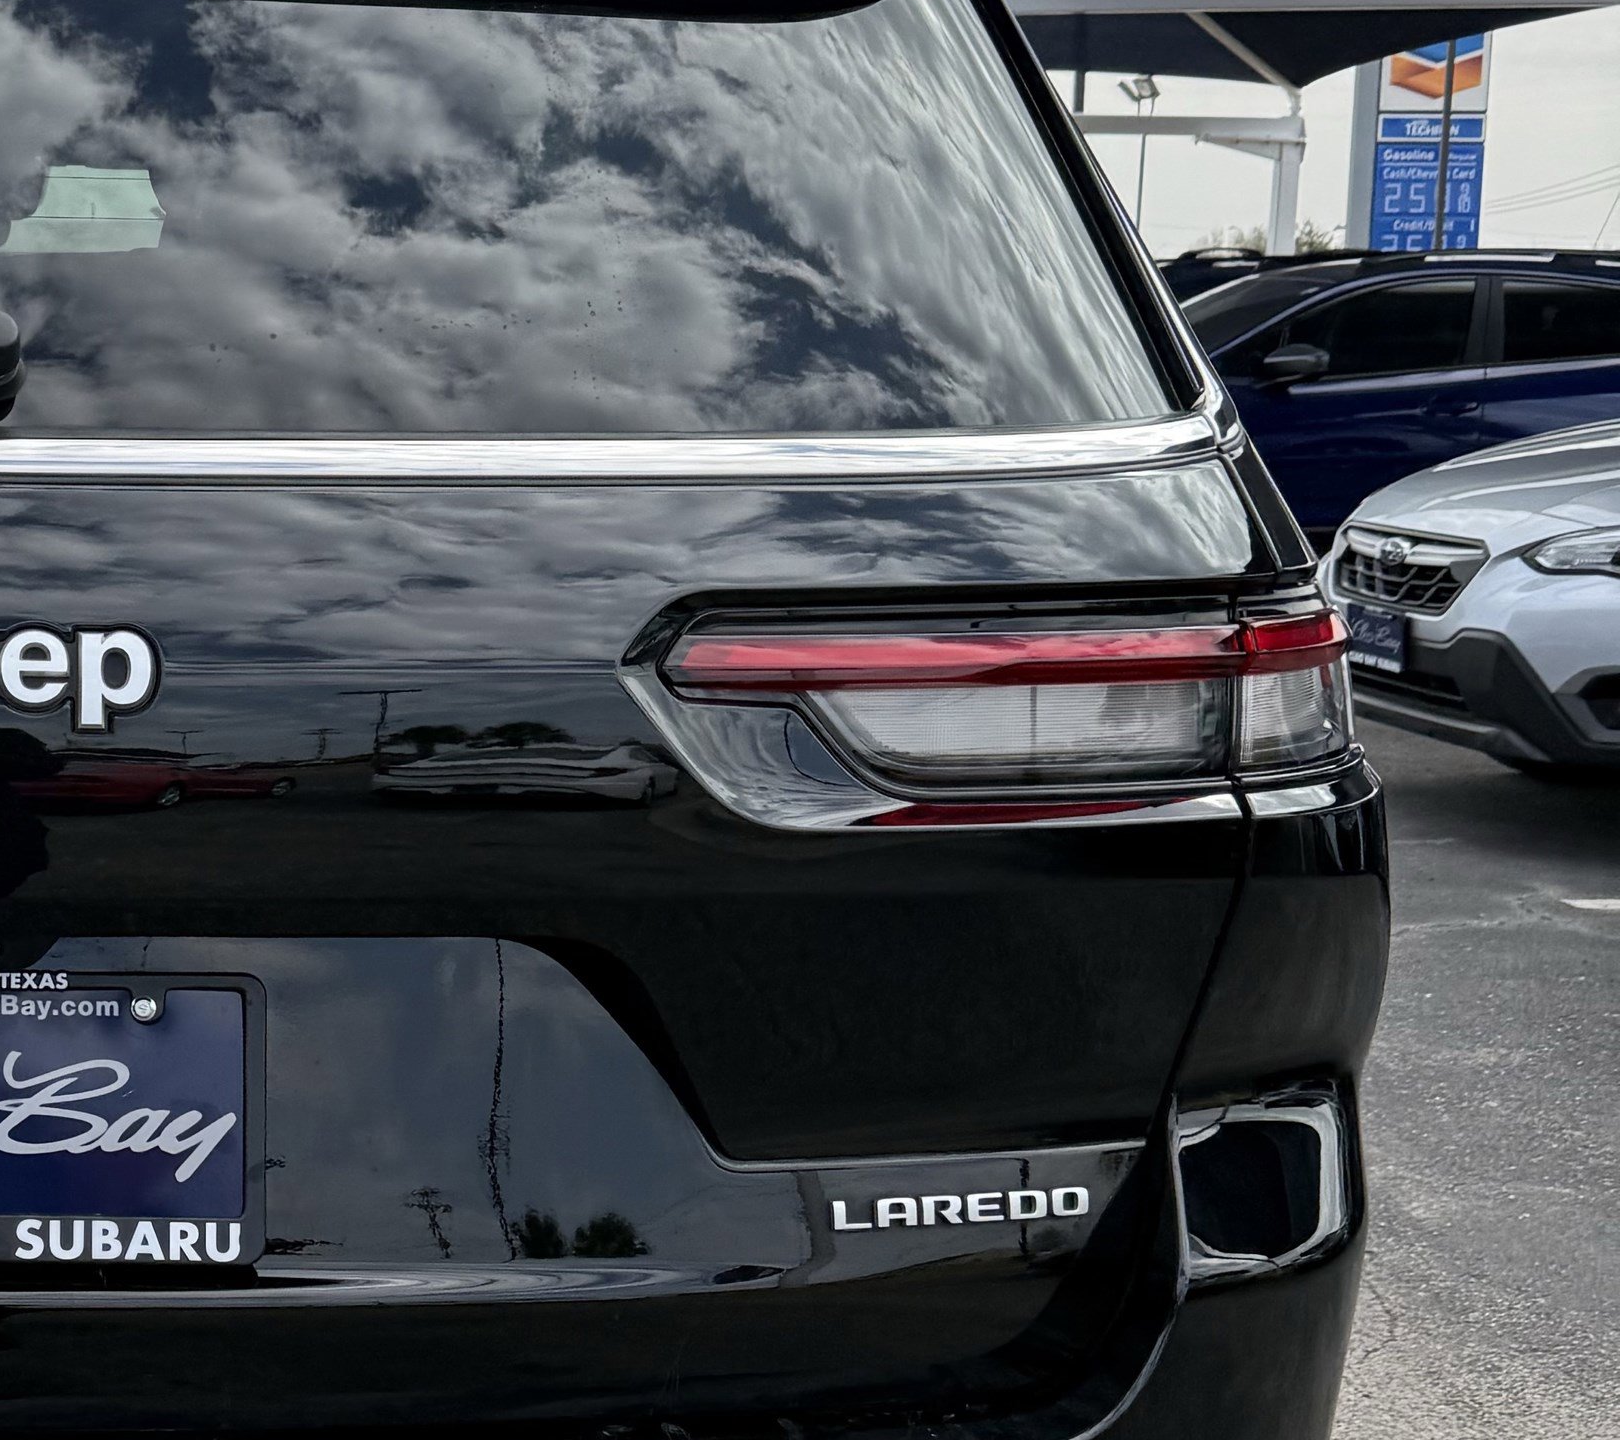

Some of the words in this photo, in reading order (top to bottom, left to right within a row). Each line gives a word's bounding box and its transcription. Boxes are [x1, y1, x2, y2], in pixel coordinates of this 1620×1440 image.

[1383, 149, 1436, 161] Gasoline
[1452, 167, 1476, 180] Card
[831, 1186, 1091, 1232] LAREDO
[14, 1218, 242, 1263] SUBARU
